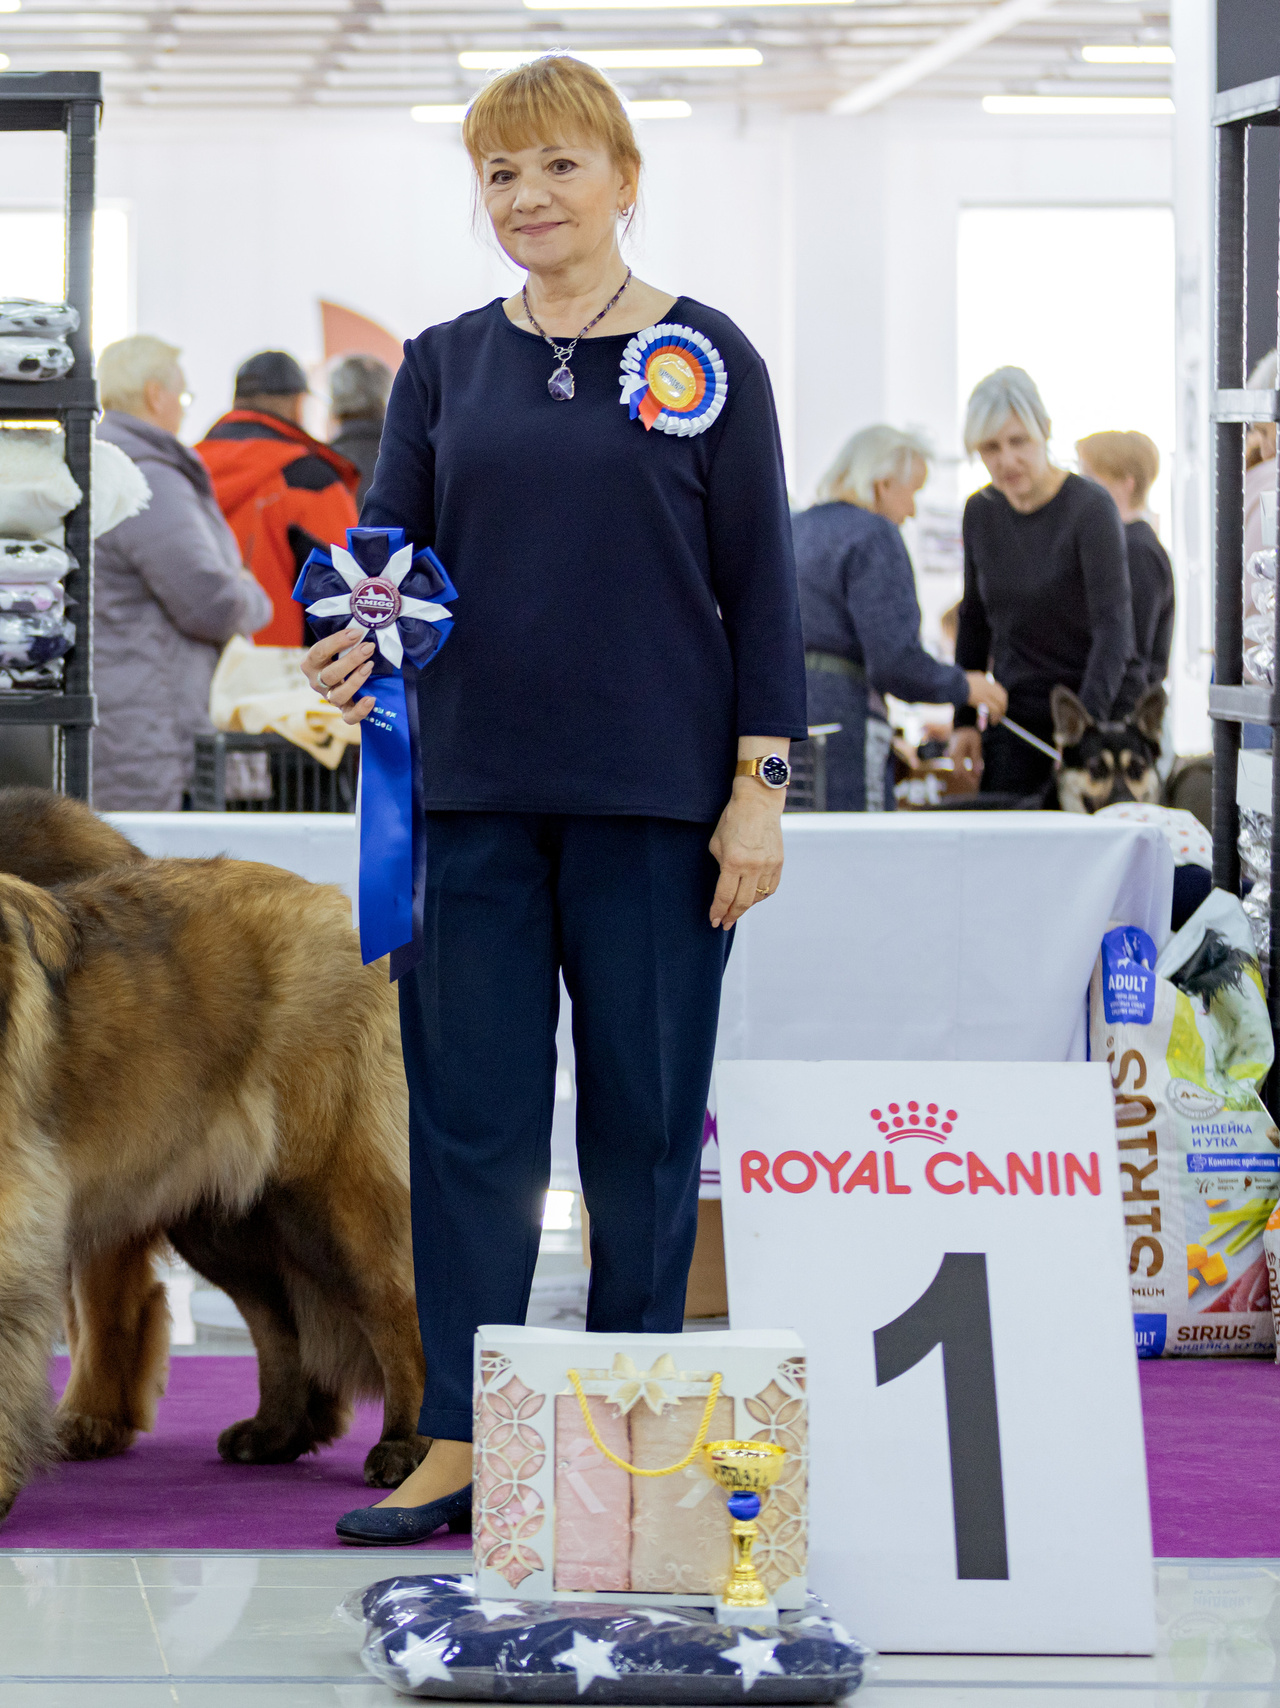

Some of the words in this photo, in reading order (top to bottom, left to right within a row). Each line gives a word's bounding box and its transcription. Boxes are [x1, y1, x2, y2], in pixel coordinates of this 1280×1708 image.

[355, 598, 395, 608] AMIGO
[1108, 973, 1148, 993] ADULT
[1191, 1120, 1253, 1135] ИНДЕЙКА
[1192, 1137, 1202, 1148] И
[1205, 1137, 1238, 1148] УТКА
[1108, 1047, 1164, 1278] SIRIUS
[740, 1150, 911, 1194] ROYAL
[924, 1151, 1101, 1196] CANIN
[1131, 1287, 1165, 1297] MIUM
[1134, 1331, 1157, 1346] ULT
[1176, 1325, 1251, 1342] SIRIUS
[872, 1252, 1010, 1581] 1
